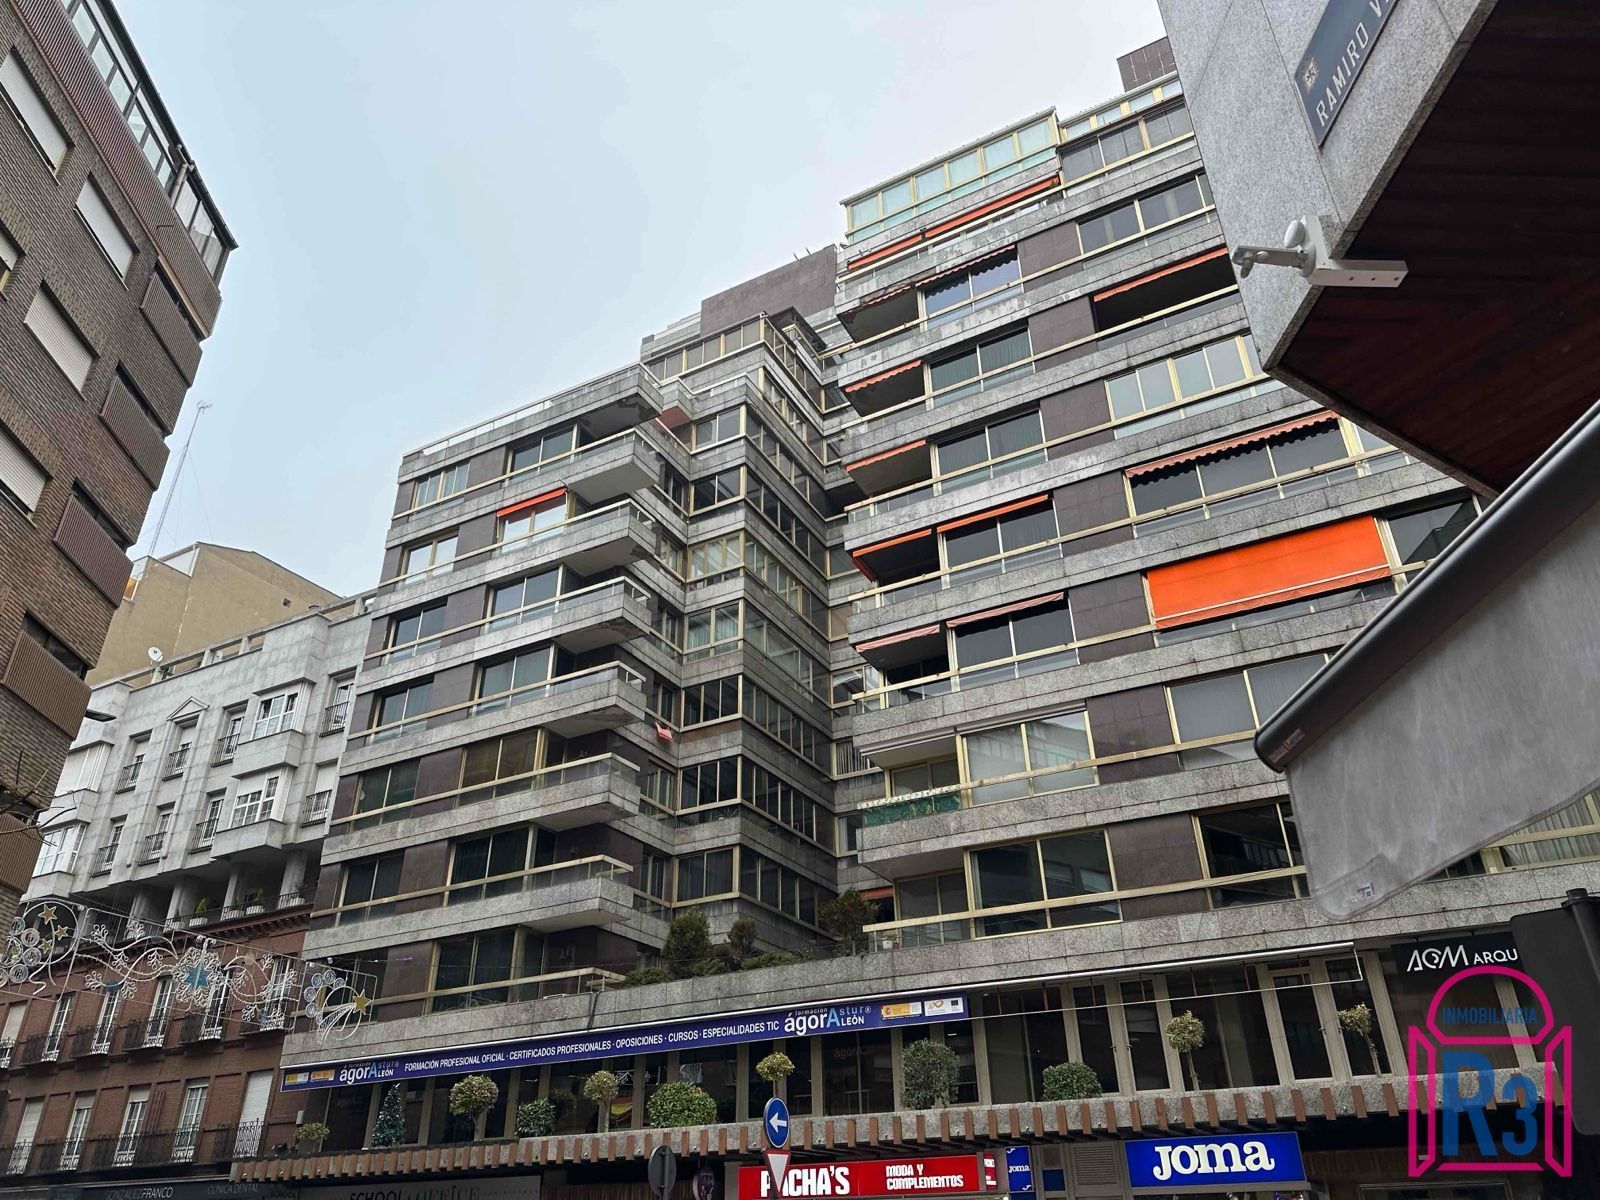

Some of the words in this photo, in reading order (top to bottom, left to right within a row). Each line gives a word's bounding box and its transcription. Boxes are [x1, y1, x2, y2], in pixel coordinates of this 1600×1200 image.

[1316, 22, 1368, 127] RAMIRO
[841, 1014, 865, 1027] LEÓN
[405, 1058, 439, 1072] FORMACIÓN
[440, 1055, 480, 1068] PROFESIONAL
[481, 1052, 504, 1063] OFICIAL
[509, 1046, 556, 1060] CERTIFICADOS
[557, 1040, 611, 1055] PROFESIONALES
[616, 1036, 663, 1049] OPOSICIONES
[668, 1030, 698, 1042] CURSOS
[703, 1022, 764, 1039] ESPECIALIDADES
[767, 1020, 780, 1031] TIC
[377, 1067, 394, 1078] LEÓN
[886, 1163, 916, 1178] MODA
[917, 1163, 924, 1176] Y
[887, 1174, 964, 1190] COMPLEMENTOS
